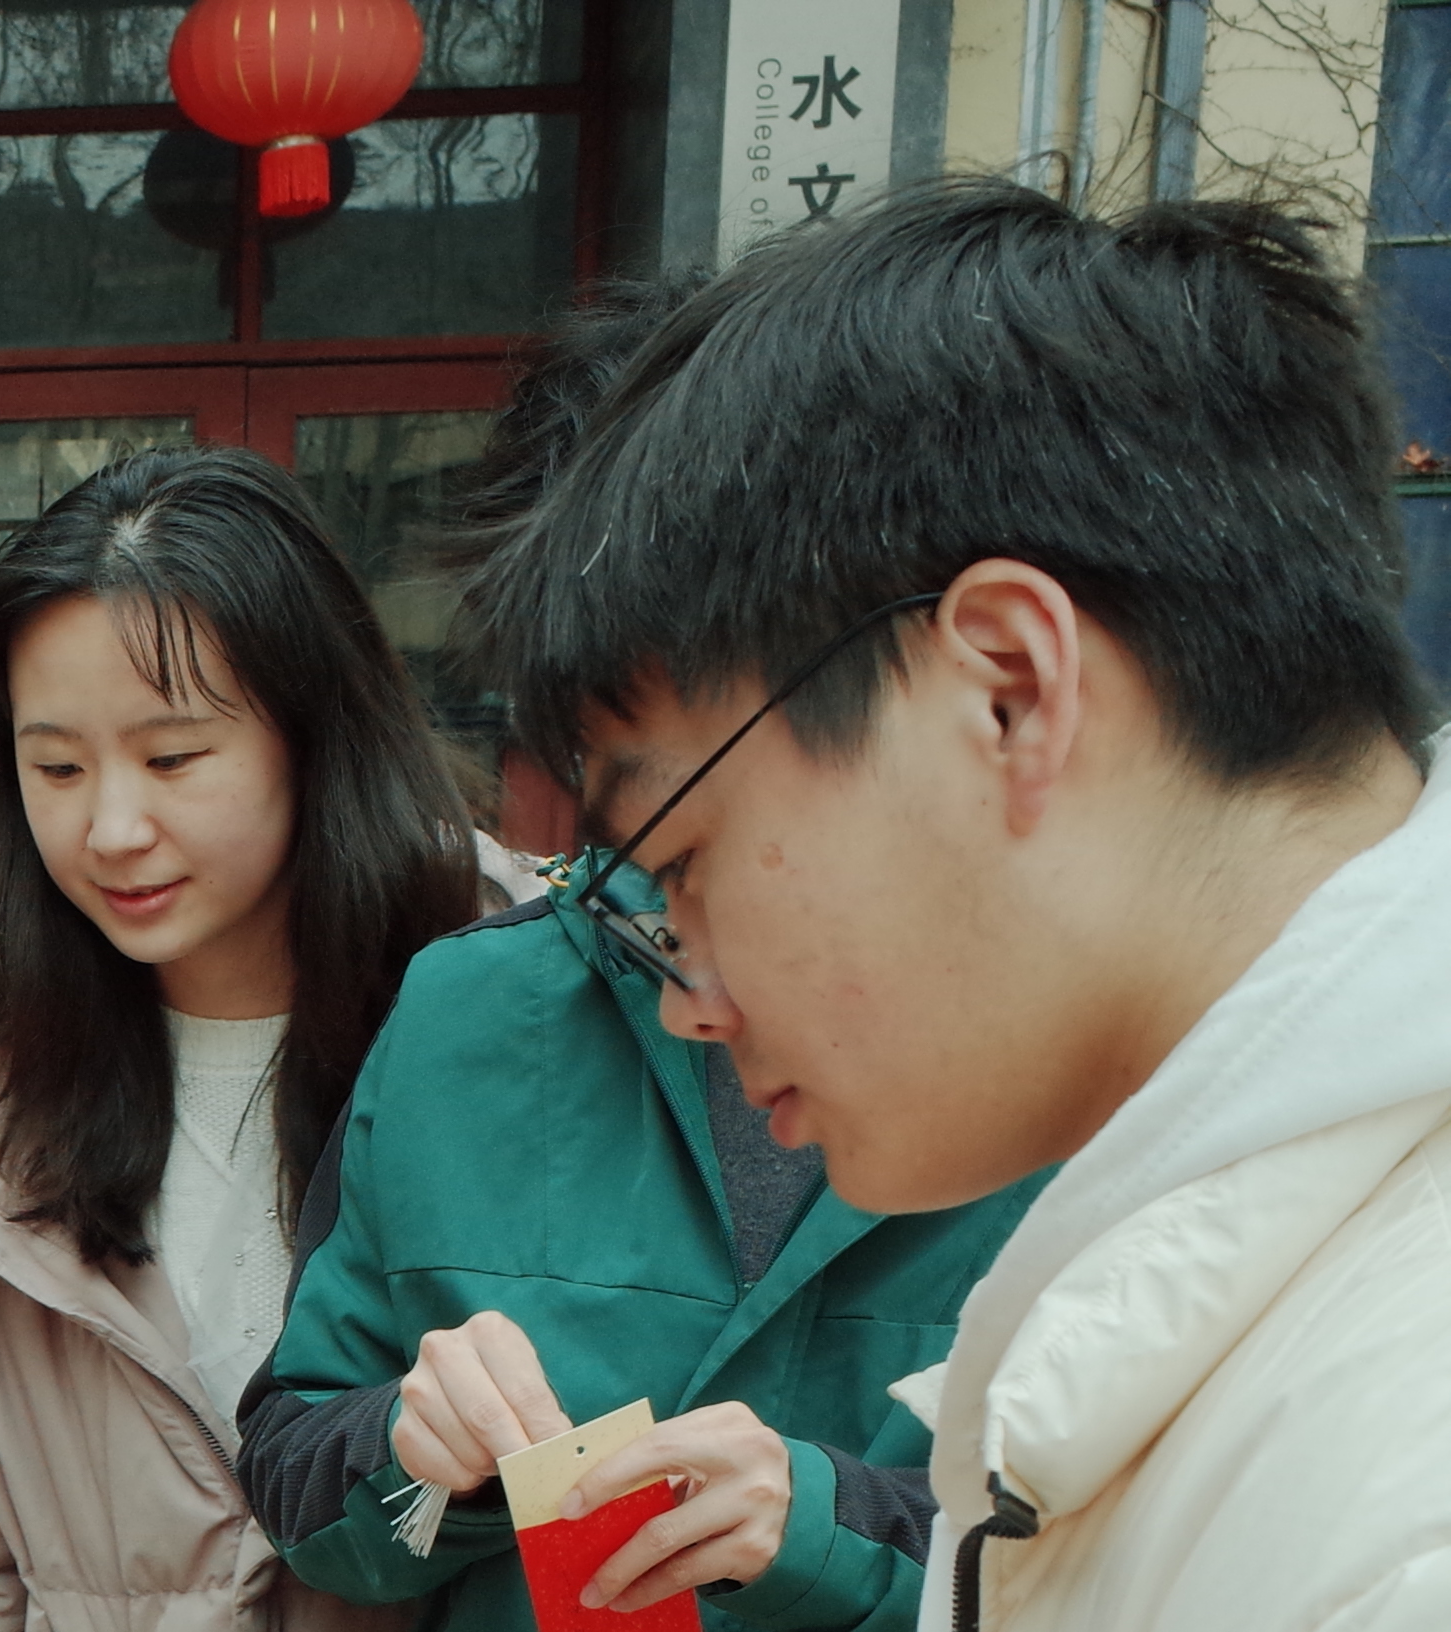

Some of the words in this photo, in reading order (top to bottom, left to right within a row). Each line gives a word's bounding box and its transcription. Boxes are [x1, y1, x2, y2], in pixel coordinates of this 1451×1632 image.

[747, 58, 782, 182] College
[789, 55, 863, 220] 水文
[750, 197, 774, 228] of
